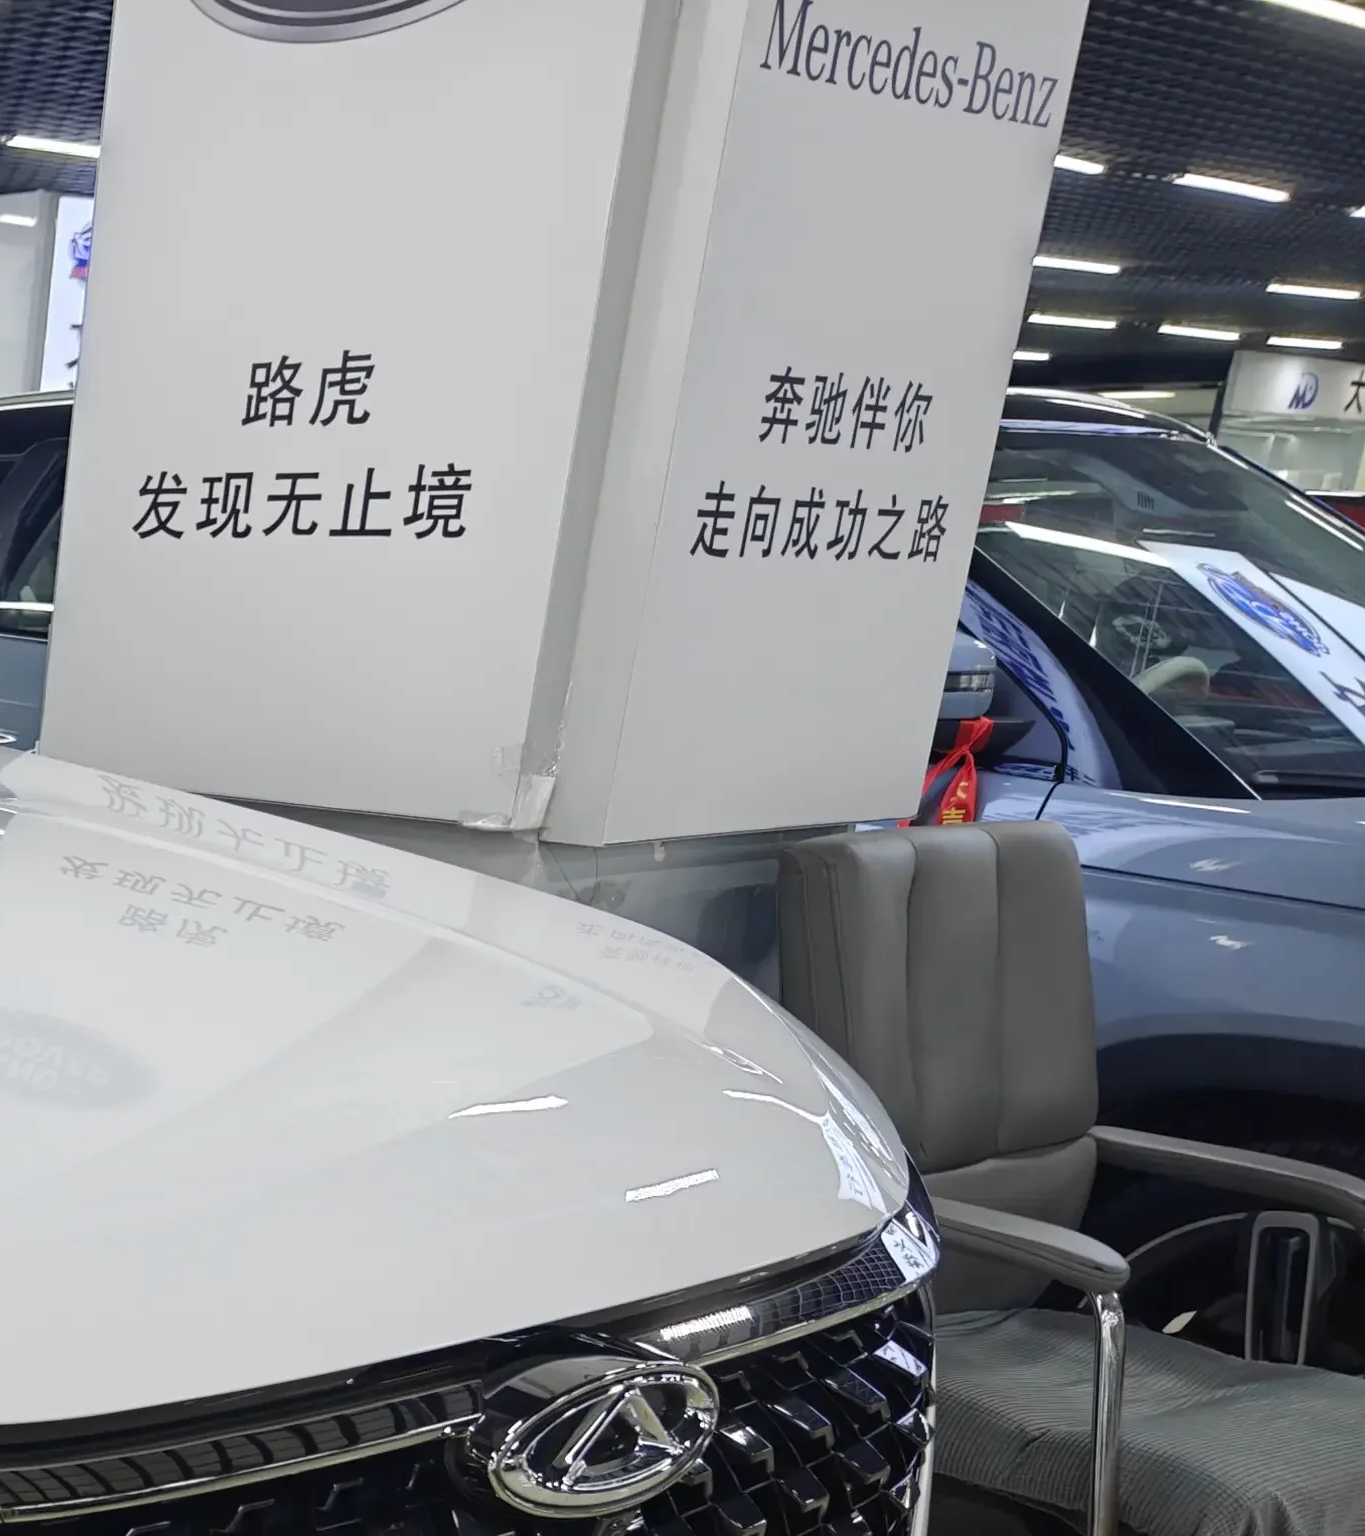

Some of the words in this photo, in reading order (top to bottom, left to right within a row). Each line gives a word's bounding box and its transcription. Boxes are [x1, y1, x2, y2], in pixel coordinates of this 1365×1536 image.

[760, 0, 1059, 128] Mercedes-Benz
[241, 349, 376, 428] 路虎
[759, 364, 933, 452] 奔驰伴你
[131, 462, 473, 541] 发现无止境
[689, 480, 950, 563] 走向成功之路
